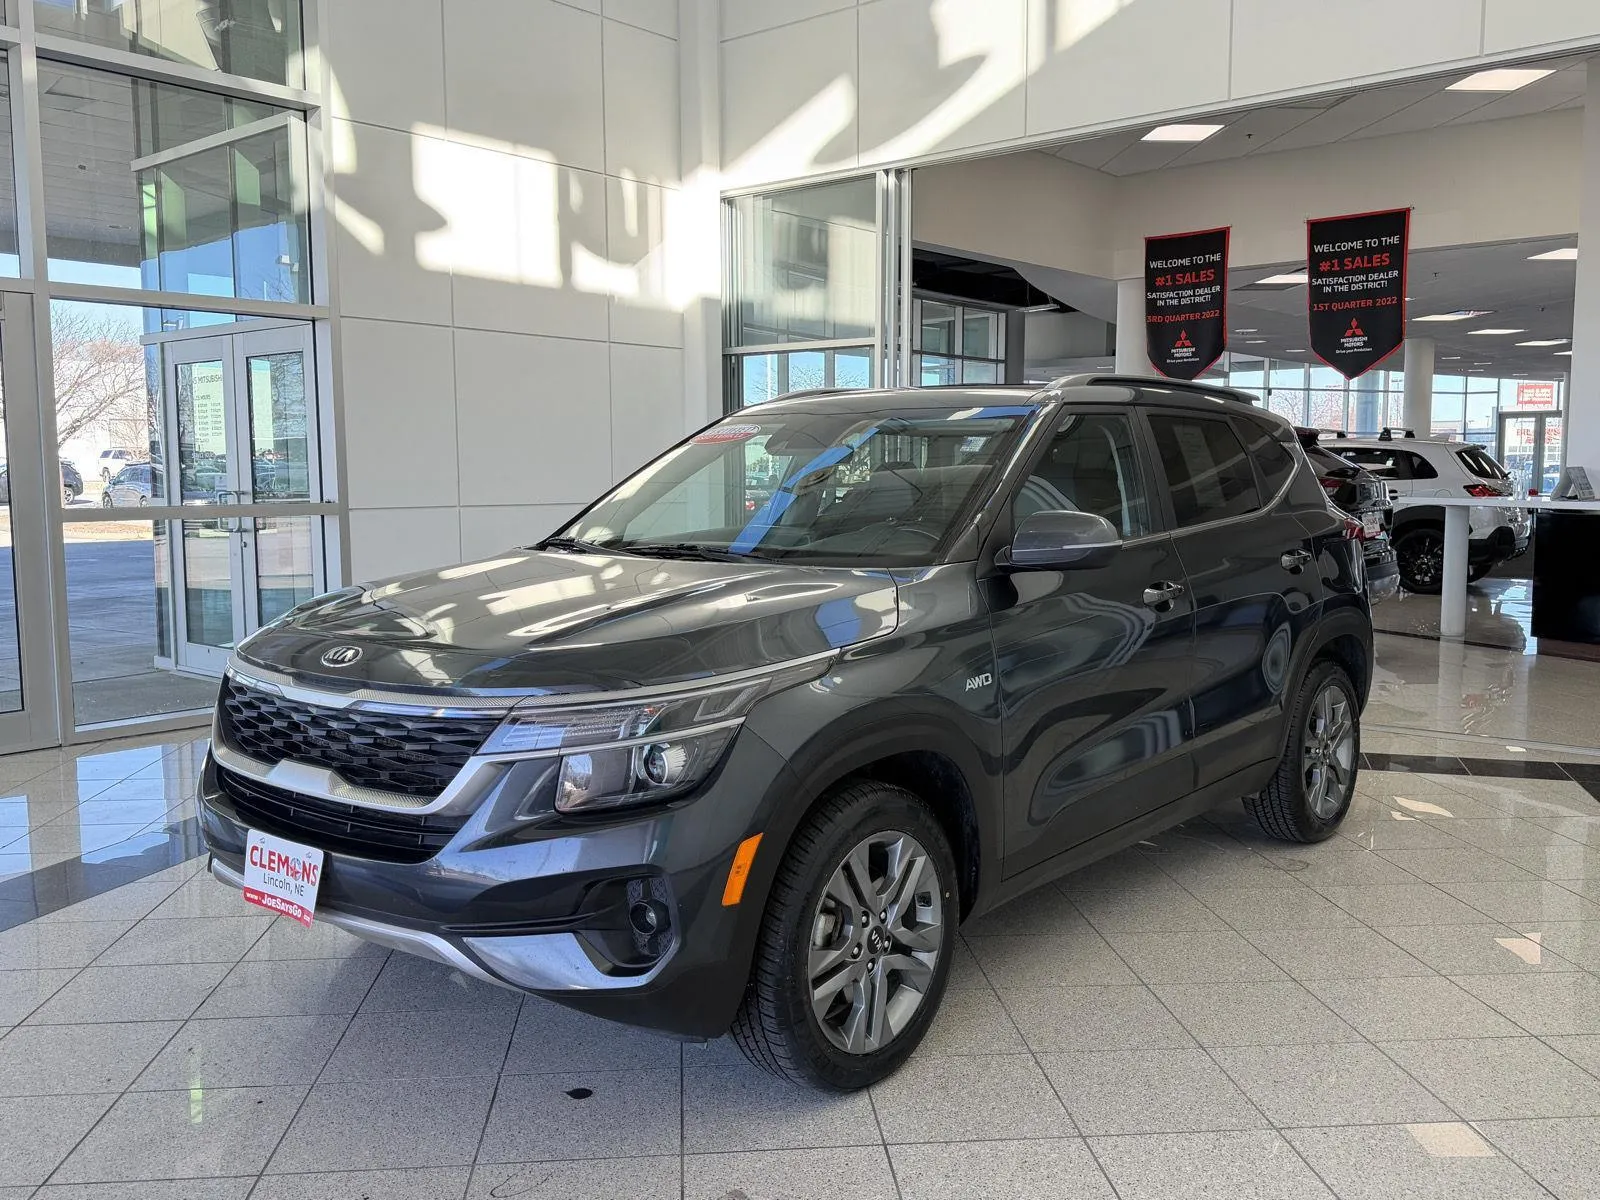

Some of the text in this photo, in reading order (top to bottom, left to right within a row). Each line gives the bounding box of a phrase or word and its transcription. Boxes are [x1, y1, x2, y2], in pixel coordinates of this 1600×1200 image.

[1314, 236, 1400, 253] WELCOME TO THE
[1150, 253, 1221, 269] WELCOME TO THE
[1319, 253, 1390, 272] #1 SALES
[1155, 269, 1214, 287] #1 SALES
[1312, 270, 1399, 286] SATISFACTION DEALER
[1147, 285, 1220, 299] SATISFACTION DEALER
[1323, 280, 1388, 293] IN THE DISTRICT!
[1166, 297, 1179, 306] THE
[1313, 296, 1397, 312] 1ST QUARTER 2022
[1147, 310, 1220, 323] 3RD QUARTER 2022
[325, 648, 355, 661] KIA
[965, 673, 992, 691] AWD
[250, 845, 319, 886] CLEMONS
[263, 873, 305, 896] Lincoln, NE
[872, 930, 882, 950] KIA
